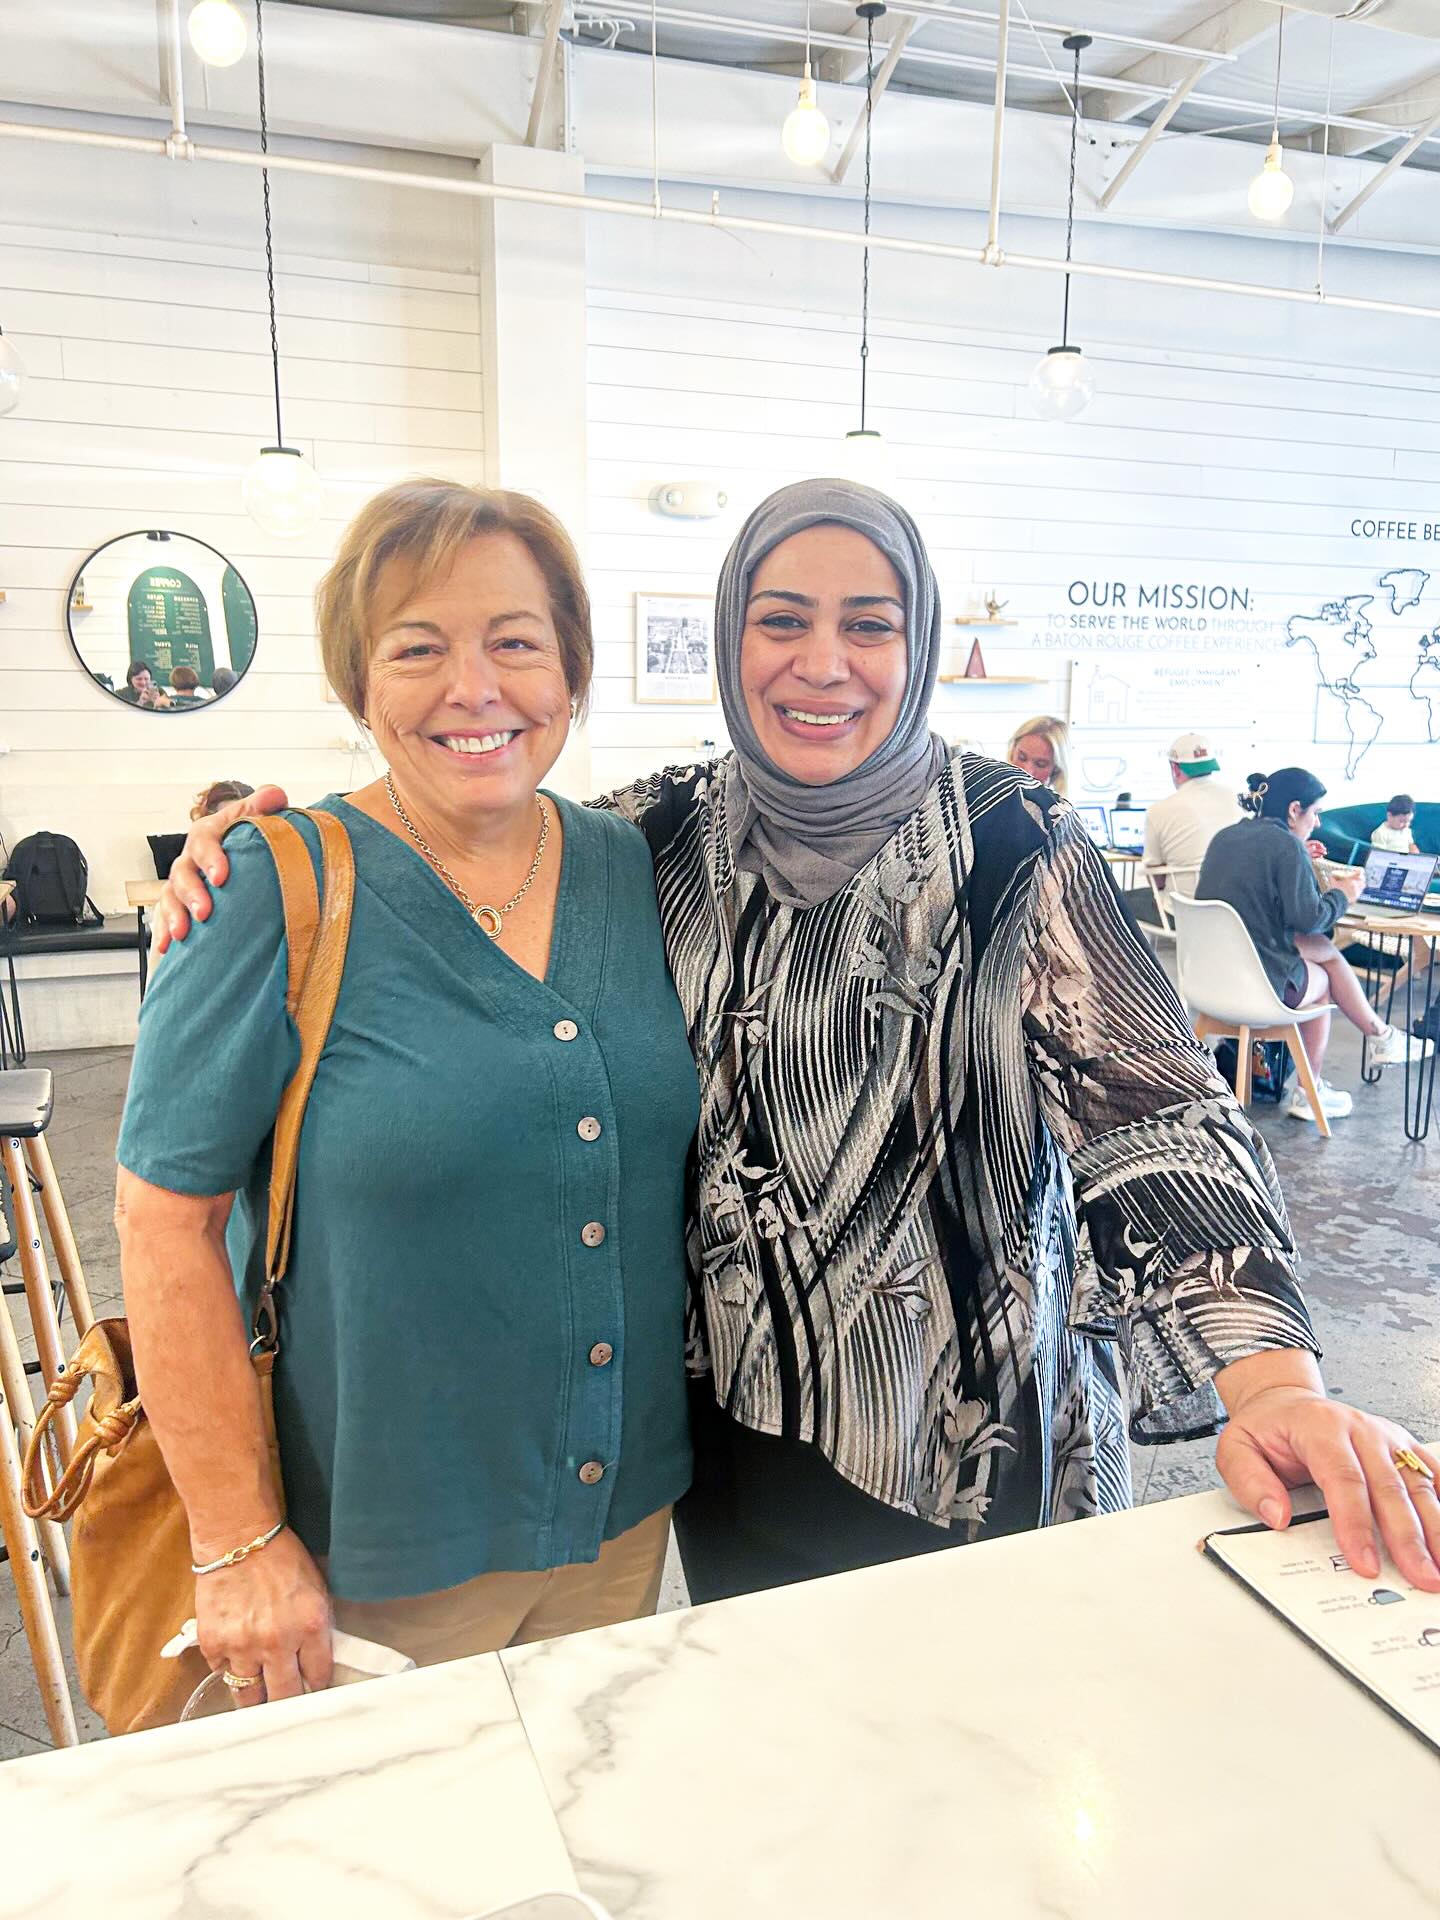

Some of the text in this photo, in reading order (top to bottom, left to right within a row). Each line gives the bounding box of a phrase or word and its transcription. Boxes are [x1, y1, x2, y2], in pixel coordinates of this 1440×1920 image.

[1351, 519, 1417, 540] COFFEE
[1068, 580, 1254, 611] OUR MISSION:
[1047, 613, 1273, 633] TO SERVE THE WORLD THROUGH
[1031, 632, 1281, 651] A BATON ROUGE COFFEE EXPERIENCE
